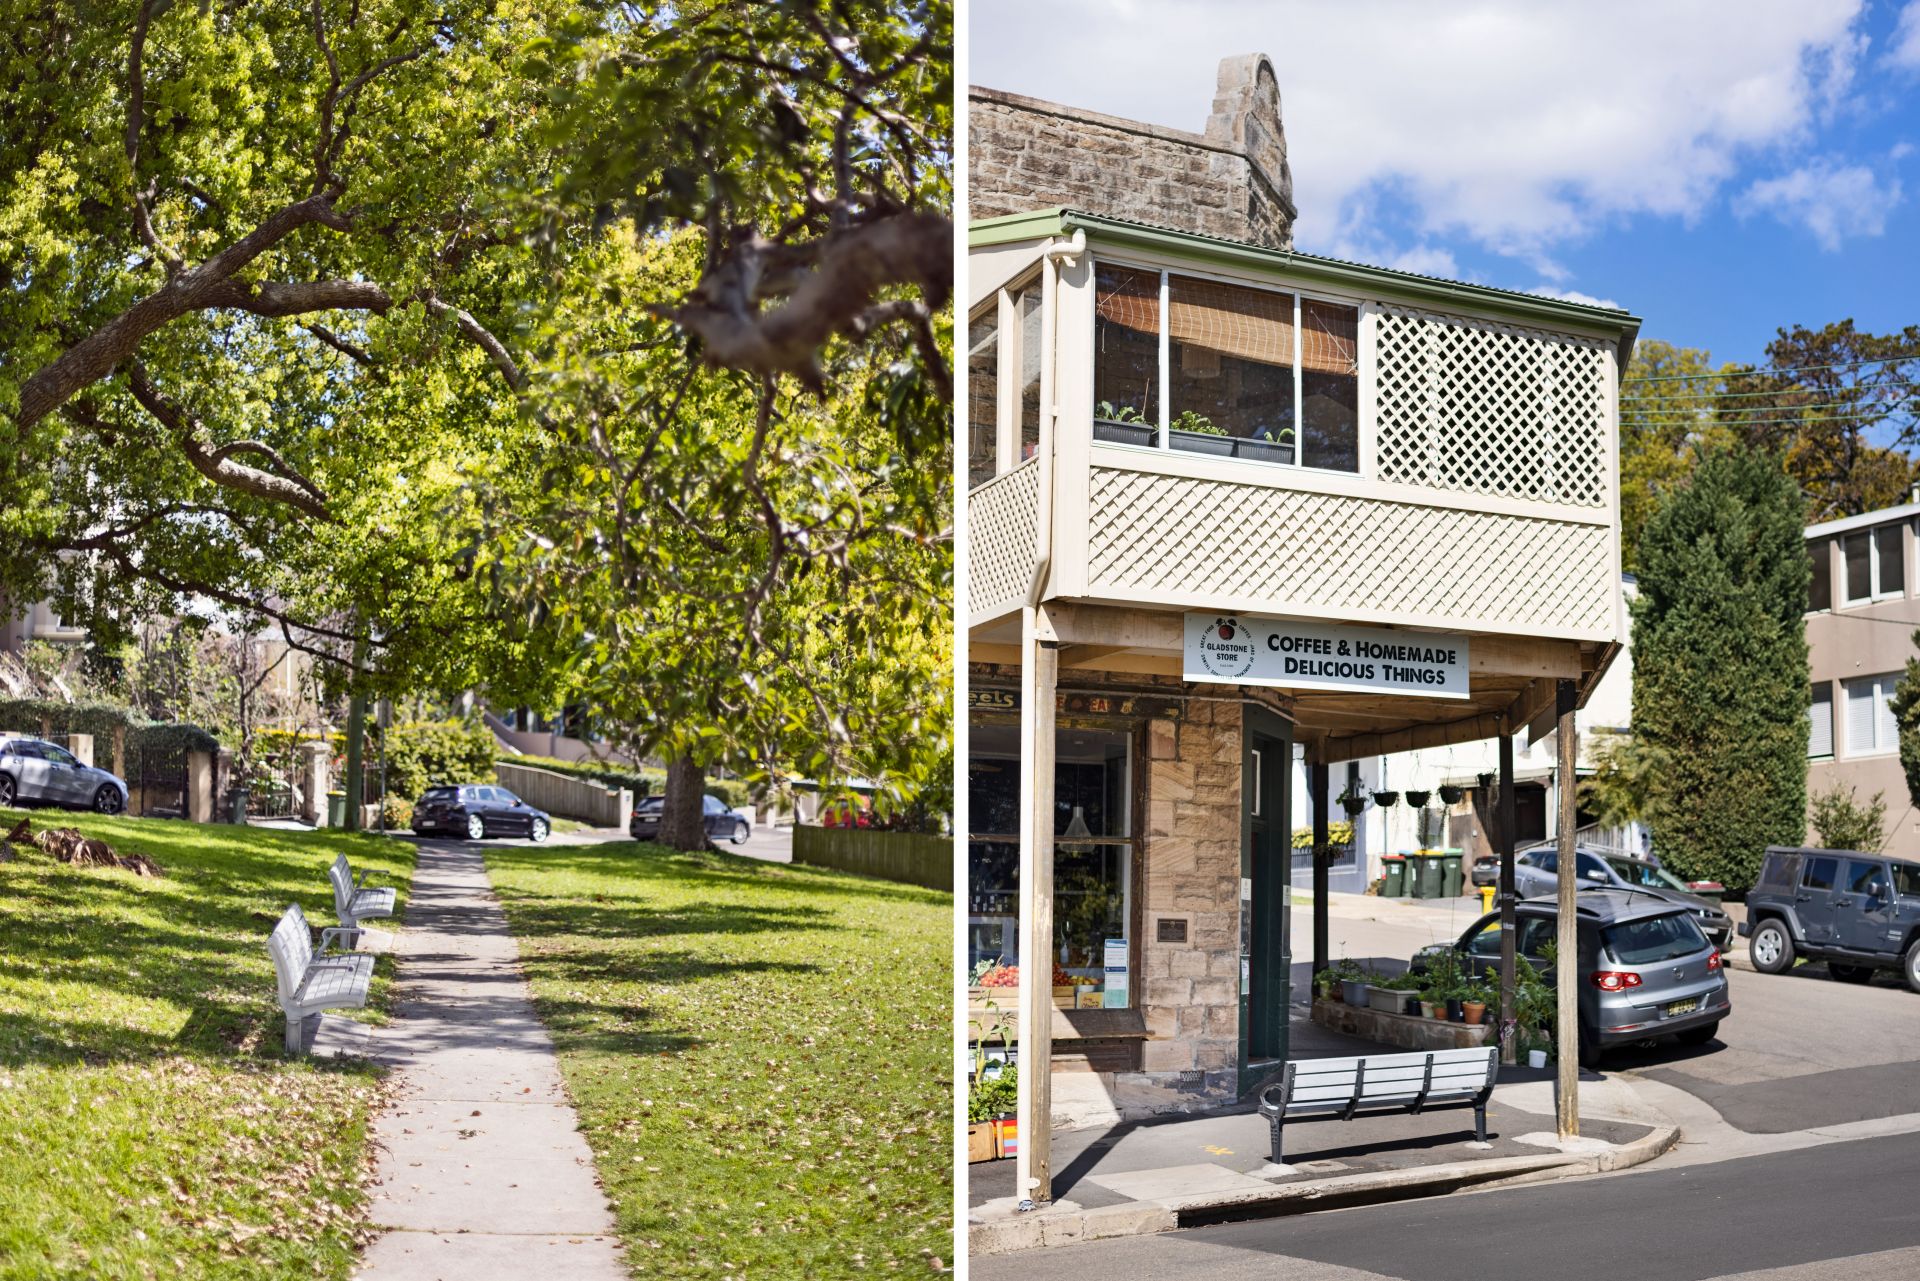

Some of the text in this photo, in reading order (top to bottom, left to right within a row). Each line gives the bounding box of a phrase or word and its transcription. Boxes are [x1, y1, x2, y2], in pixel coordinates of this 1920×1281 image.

[1238, 624, 1252, 639] COFFEE
[1206, 642, 1248, 653] GLADSTONE
[1267, 633, 1456, 665] COFFEE & HOMEMADE
[1216, 653, 1238, 661] STORE
[1284, 656, 1446, 685] DELICIOUS THINGS
